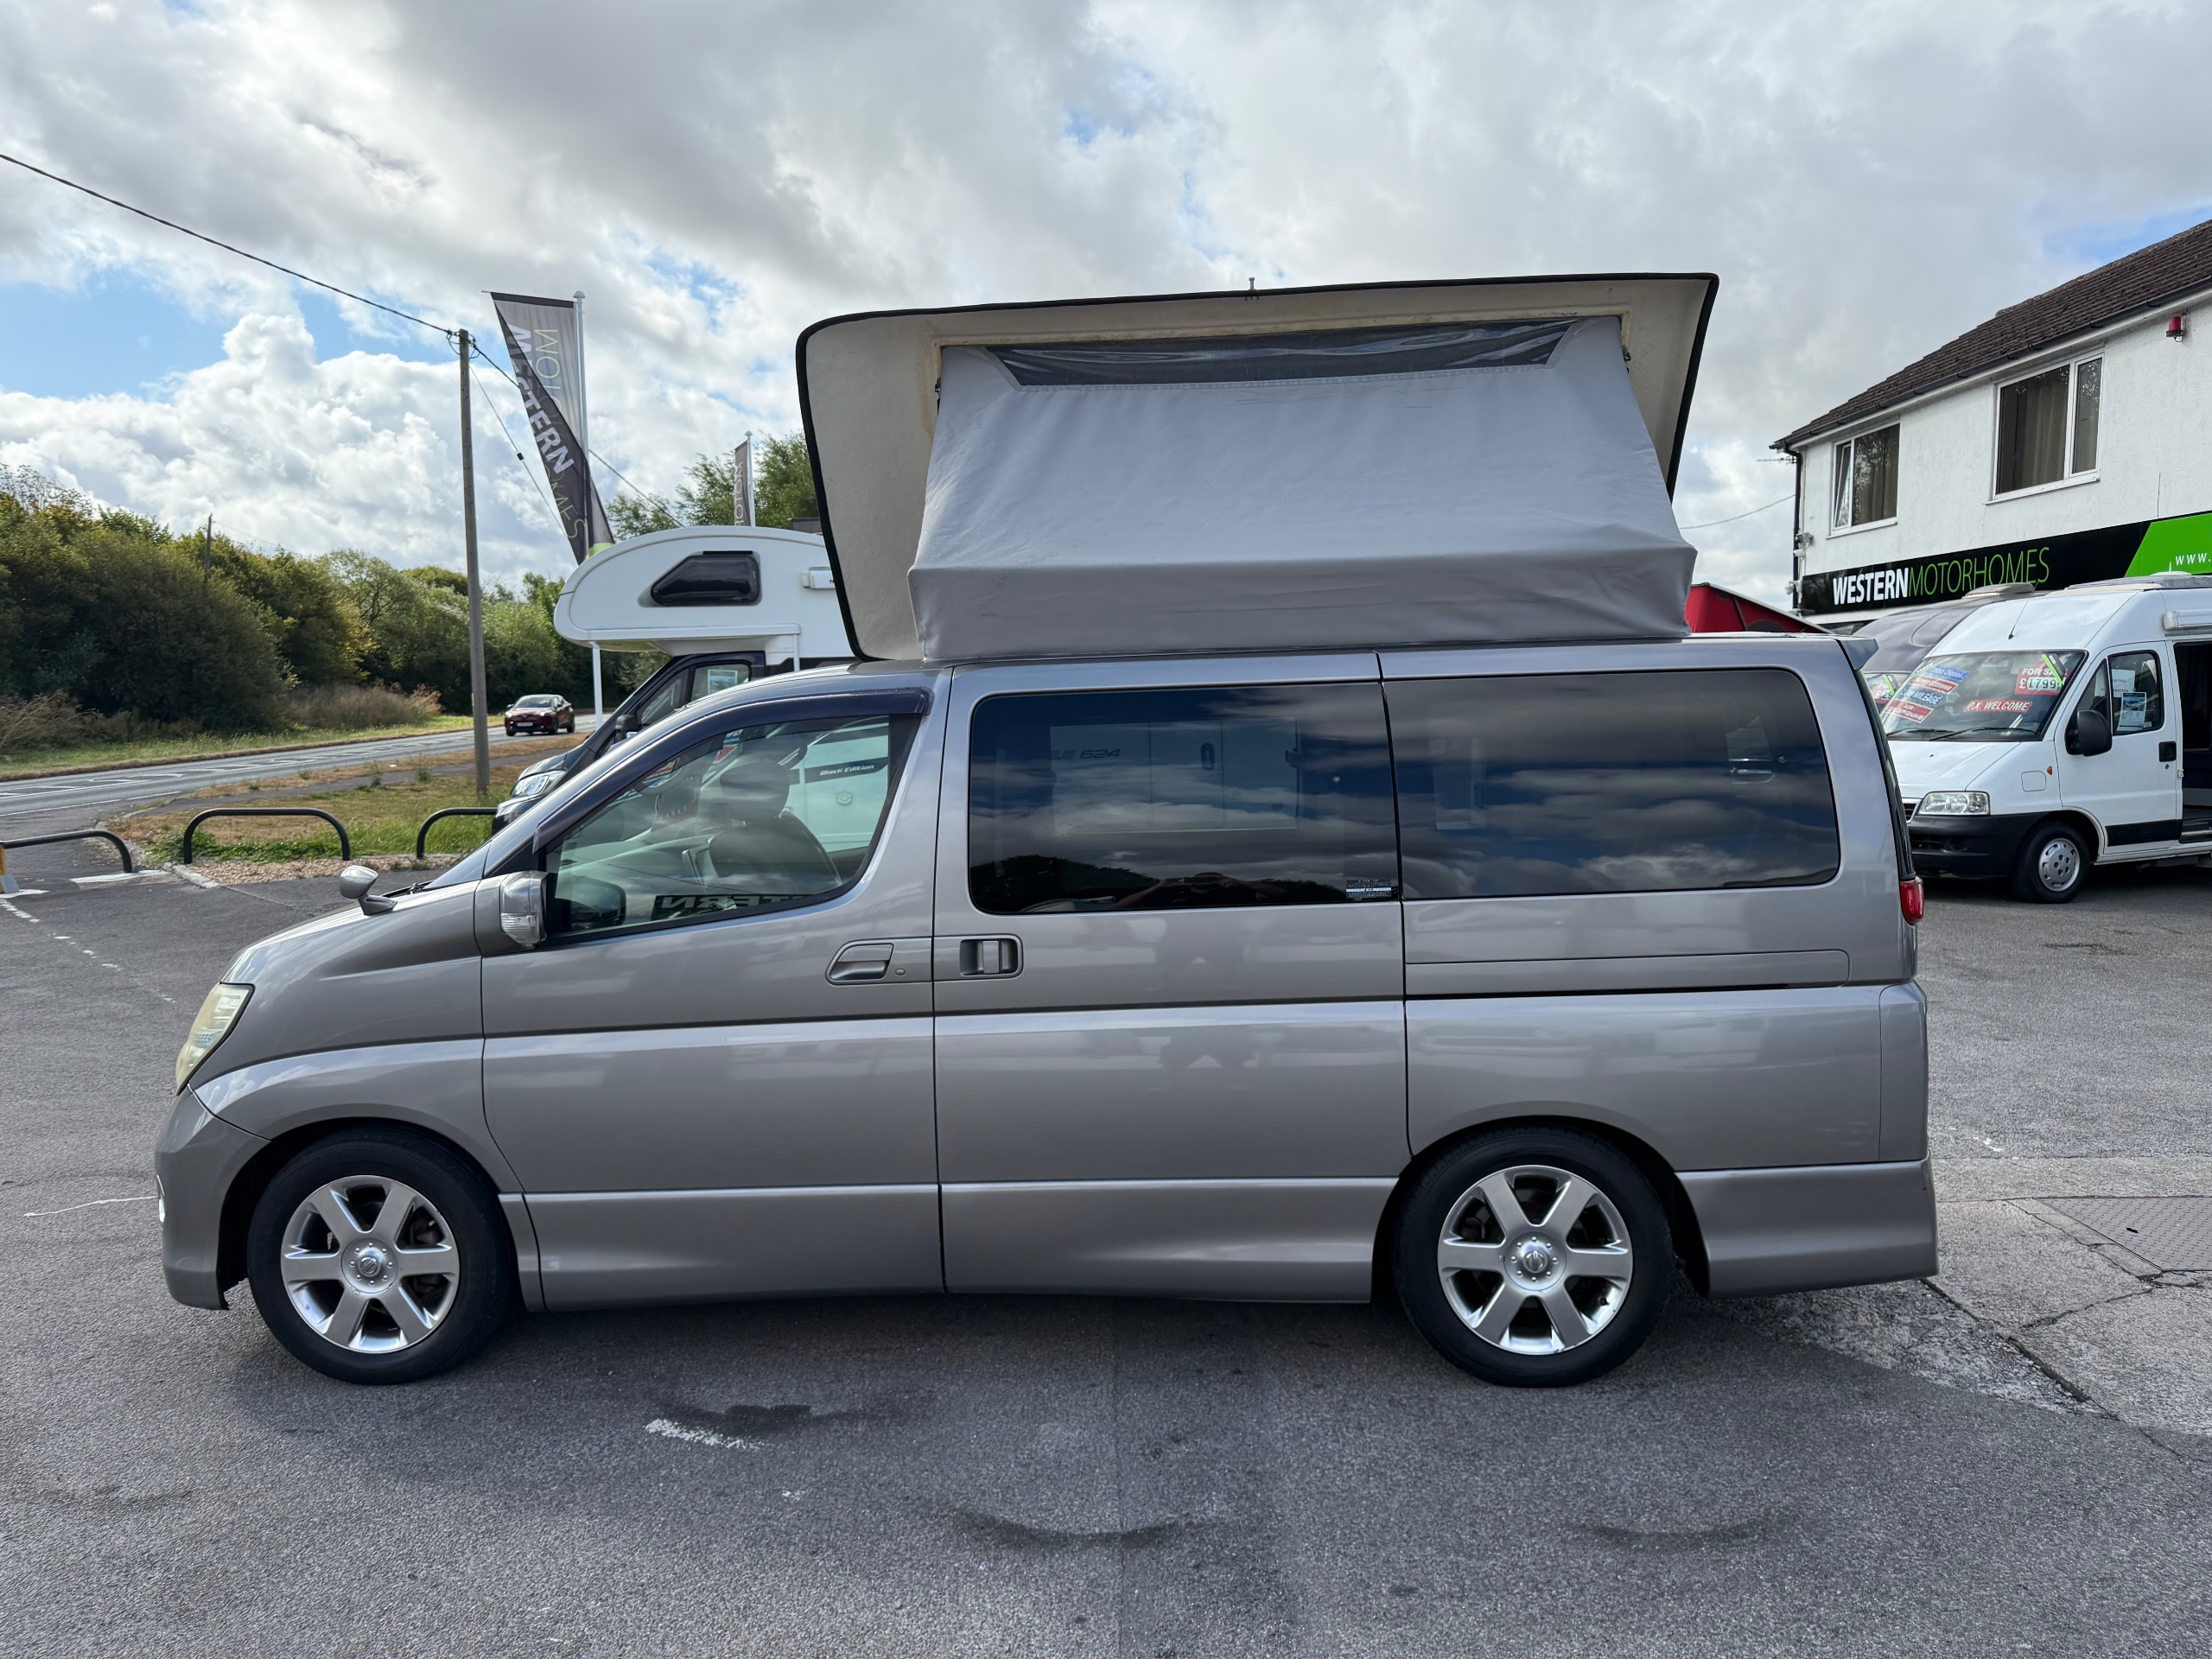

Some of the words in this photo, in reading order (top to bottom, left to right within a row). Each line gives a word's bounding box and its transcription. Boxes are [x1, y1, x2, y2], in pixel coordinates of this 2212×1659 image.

[2019, 677, 2061, 690] £1799
[1983, 701, 2031, 711] WELCOME
[1079, 748, 1121, 759] 624
